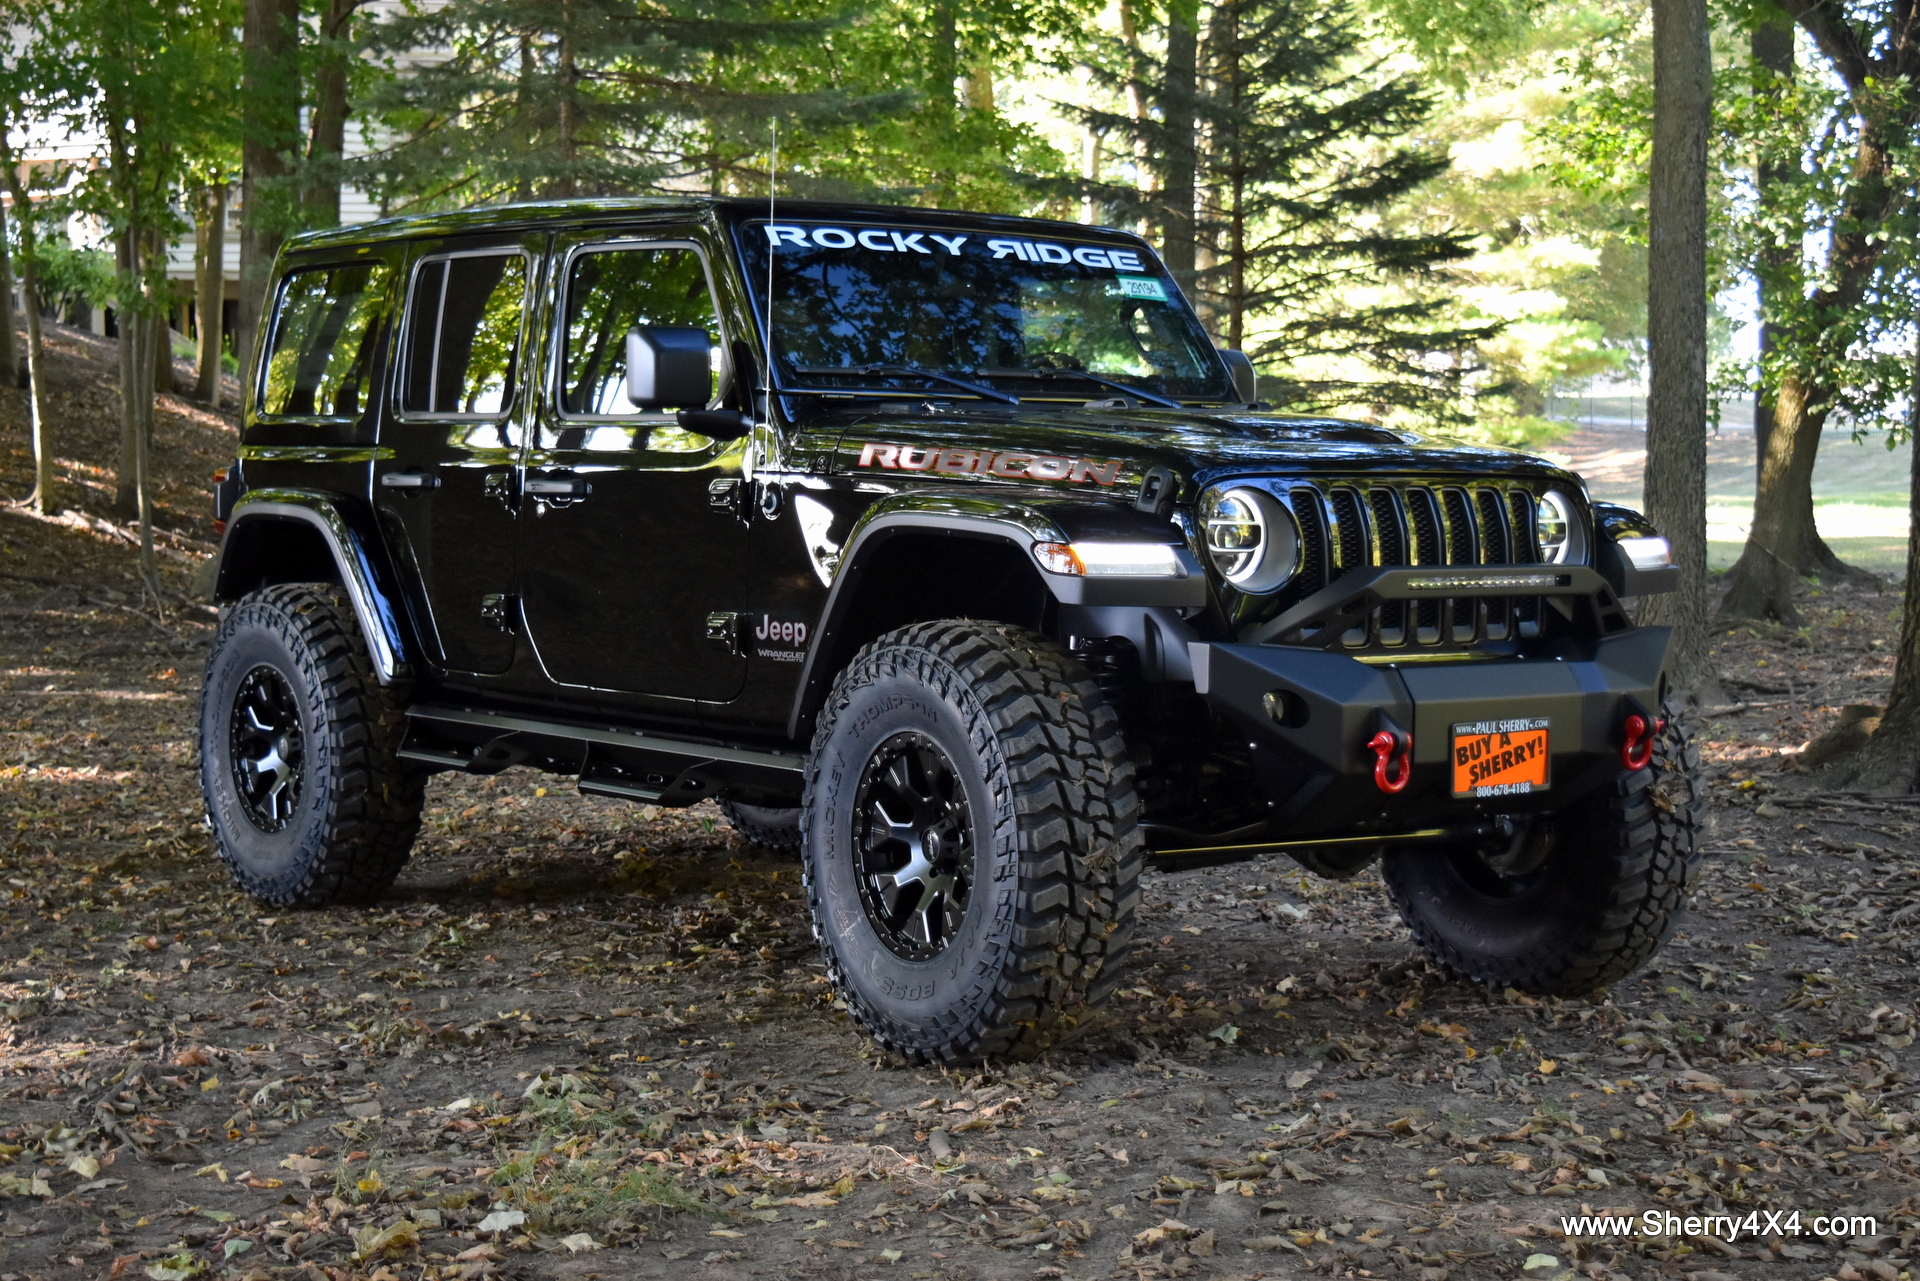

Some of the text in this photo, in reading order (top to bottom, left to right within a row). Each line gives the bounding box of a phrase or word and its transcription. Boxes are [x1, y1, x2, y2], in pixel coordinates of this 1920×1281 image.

[763, 225, 967, 256] ROCKY
[858, 442, 1122, 486] RUBICON
[755, 614, 807, 647] Jeep
[1475, 721, 1497, 735] PAUL
[1498, 719, 1531, 734] SHERRY
[1456, 733, 1512, 767] BUY A
[1469, 736, 1543, 784] SHERRY!
